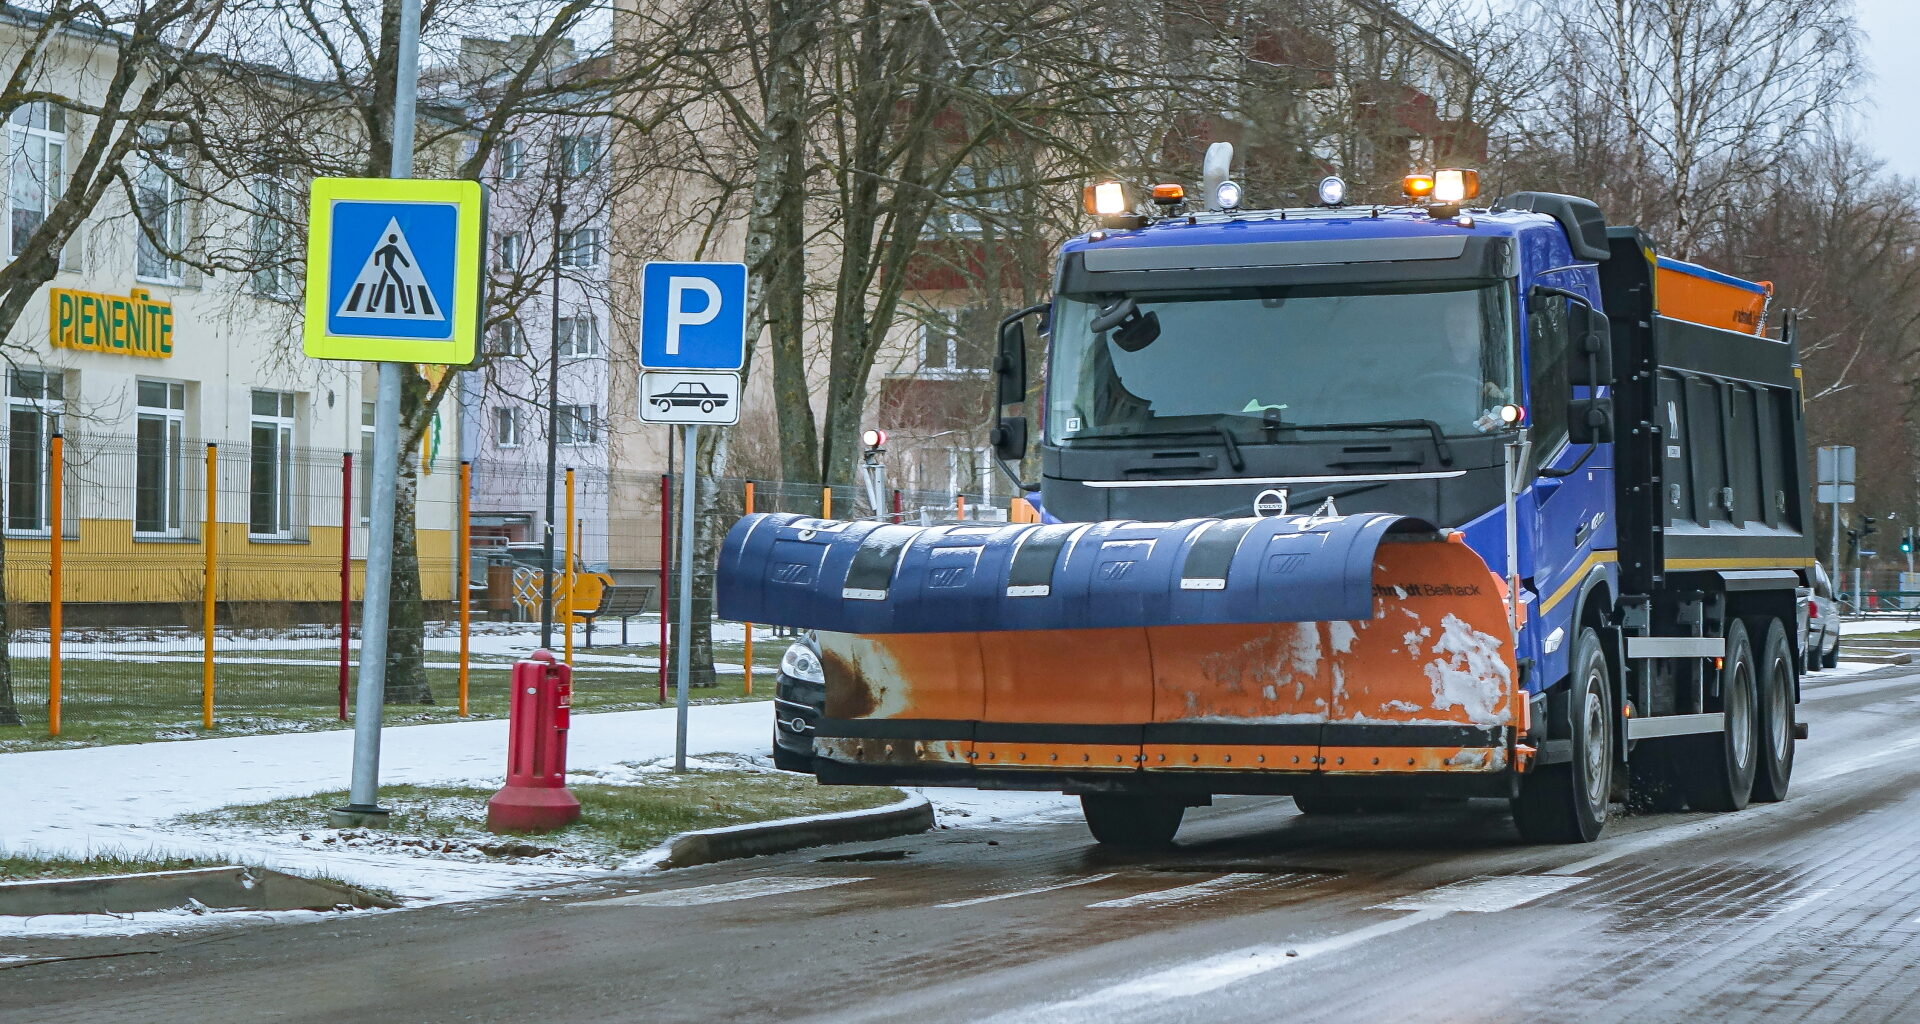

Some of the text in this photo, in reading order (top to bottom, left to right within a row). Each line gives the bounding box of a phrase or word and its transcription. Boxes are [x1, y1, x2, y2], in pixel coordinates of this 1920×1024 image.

[60, 293, 172, 353] PIENENĪTE
[665, 276, 723, 355] P
[1424, 583, 1481, 598] Beilhack
